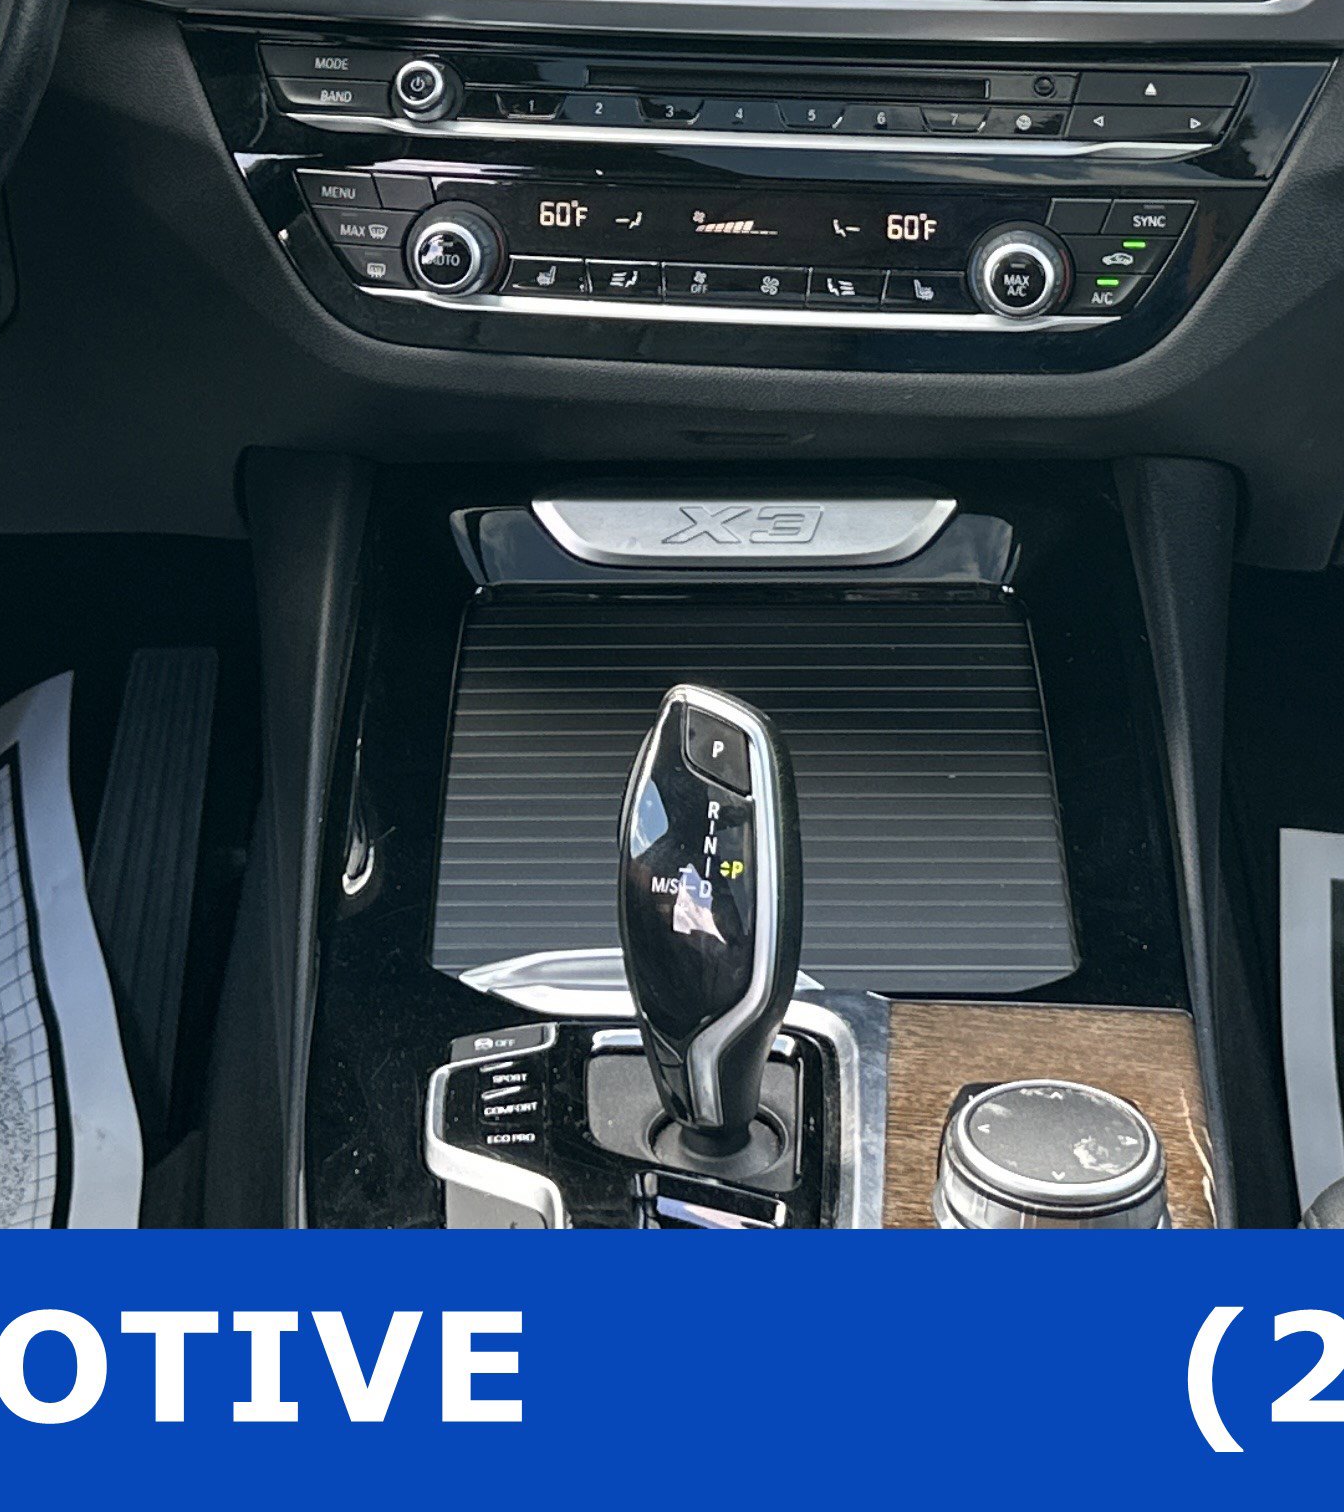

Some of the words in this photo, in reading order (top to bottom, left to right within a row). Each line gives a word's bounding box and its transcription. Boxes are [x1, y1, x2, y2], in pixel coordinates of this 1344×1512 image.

[314, 57, 350, 71] MODE
[319, 89, 353, 104] BAND
[527, 99, 536, 112] 1
[594, 102, 604, 115] 2
[665, 105, 675, 119] 3
[735, 107, 744, 120] 4
[807, 108, 817, 122] 5
[876, 111, 887, 125] 6
[950, 113, 959, 126] 7
[321, 185, 356, 200] MENU
[1132, 214, 1167, 229] SYNC
[340, 224, 366, 238] MAX
[1003, 274, 1030, 287] MAX
[690, 283, 709, 295] OFF
[1006, 284, 1027, 297] A/C
[1091, 291, 1114, 306] A/C
[661, 505, 825, 545] X3
[711, 740, 725, 758] P
[707, 801, 721, 820] R
[703, 836, 718, 855] N
[731, 860, 745, 880] P
[651, 876, 679, 894] M/S
[698, 880, 713, 899] D
[492, 1072, 528, 1084] SPORT
[484, 1101, 538, 1116] COMFORT
[487, 1134, 509, 1145] ECO
[511, 1133, 536, 1144] PRO
